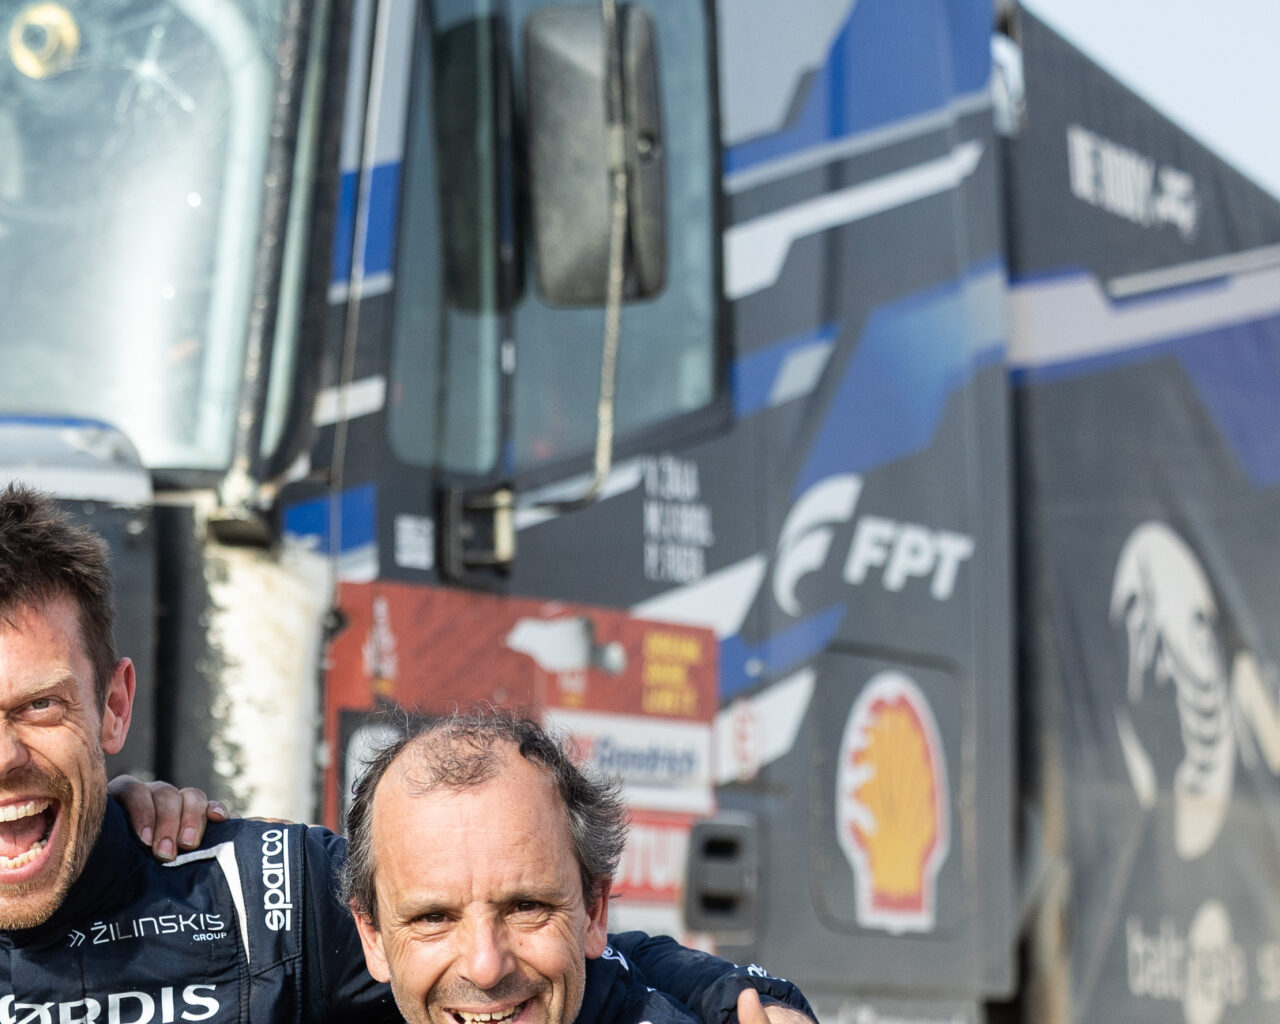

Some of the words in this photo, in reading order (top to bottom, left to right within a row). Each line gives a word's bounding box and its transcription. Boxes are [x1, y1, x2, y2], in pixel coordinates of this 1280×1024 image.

[842, 513, 976, 601] FPT
[262, 828, 292, 931] sparco
[192, 932, 228, 942] GROUP
